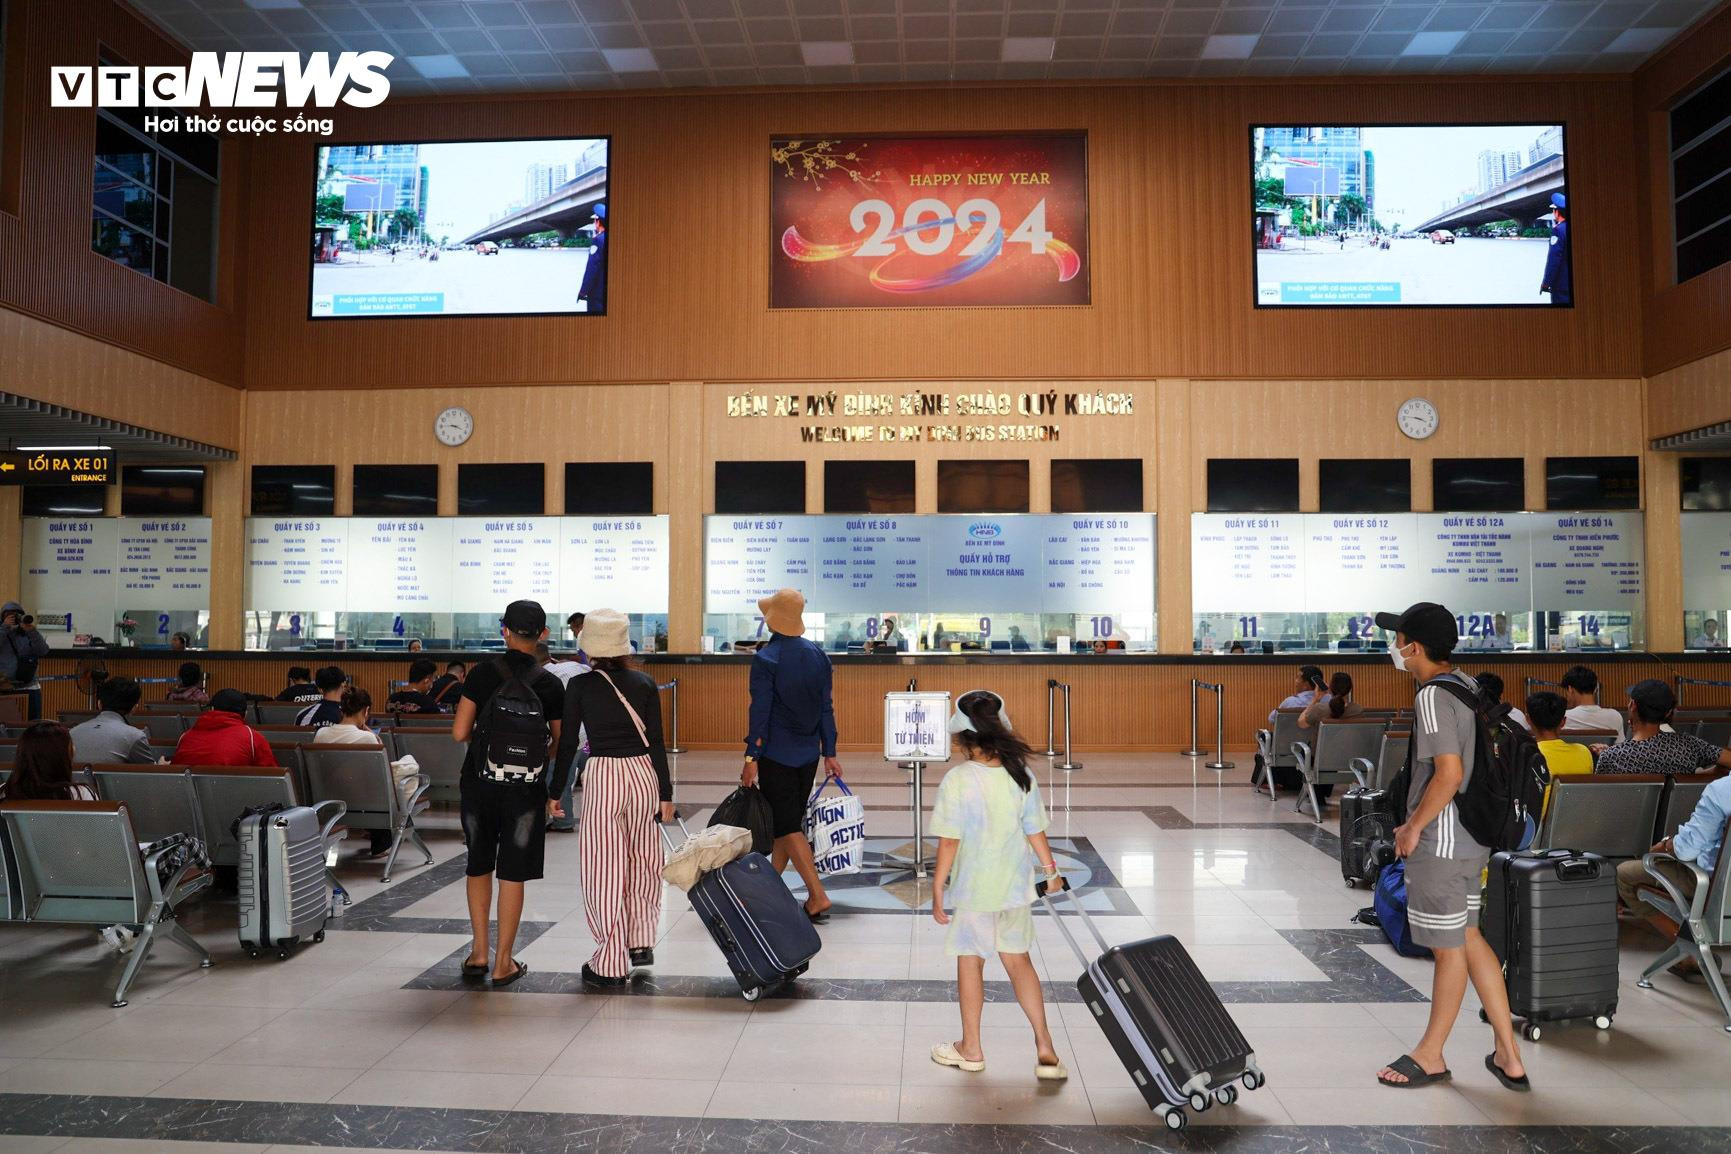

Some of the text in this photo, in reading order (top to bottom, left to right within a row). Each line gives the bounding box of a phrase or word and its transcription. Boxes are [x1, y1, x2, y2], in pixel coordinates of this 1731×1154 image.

[909, 172, 1050, 187] HAPPY NEW YEAR
[849, 197, 1054, 257] 2024
[774, 395, 800, 416] XE
[956, 389, 1011, 415] CHÀO
[1018, 389, 1058, 418] QUÝ
[1064, 389, 1134, 415] KHÁCH
[800, 426, 874, 443] WELCOME
[879, 426, 896, 442] TO
[899, 425, 922, 442] MY
[998, 425, 1060, 441] STATION
[28, 454, 108, 471] LỐI RA XE 01
[71, 474, 107, 482] ENTRANCE
[90, 523, 93, 532] 1
[181, 523, 186, 531] 2
[316, 523, 321, 531] 3
[419, 523, 424, 531] 4
[528, 523, 533, 531] 5
[637, 522, 642, 530] 6
[778, 521, 783, 530] 7
[891, 521, 897, 530] 8
[1119, 520, 1129, 529] 10
[1271, 520, 1279, 528] 11
[1379, 520, 1389, 528] 12
[1489, 518, 1504, 527] 12A
[1604, 519, 1613, 527] 14
[946, 567, 968, 577] THÔNG
[970, 568, 981, 577] TIN
[982, 567, 1005, 577] KHÁCH
[158, 614, 170, 634] 2
[392, 615, 405, 636] 4
[754, 616, 765, 638] 7
[866, 617, 878, 638] 8
[979, 616, 991, 637] 9
[1090, 616, 1113, 637] 10
[1239, 616, 1257, 638] 11
[1348, 616, 1373, 638] 12
[1456, 615, 1495, 637] 12A
[1577, 615, 1600, 637] 14
